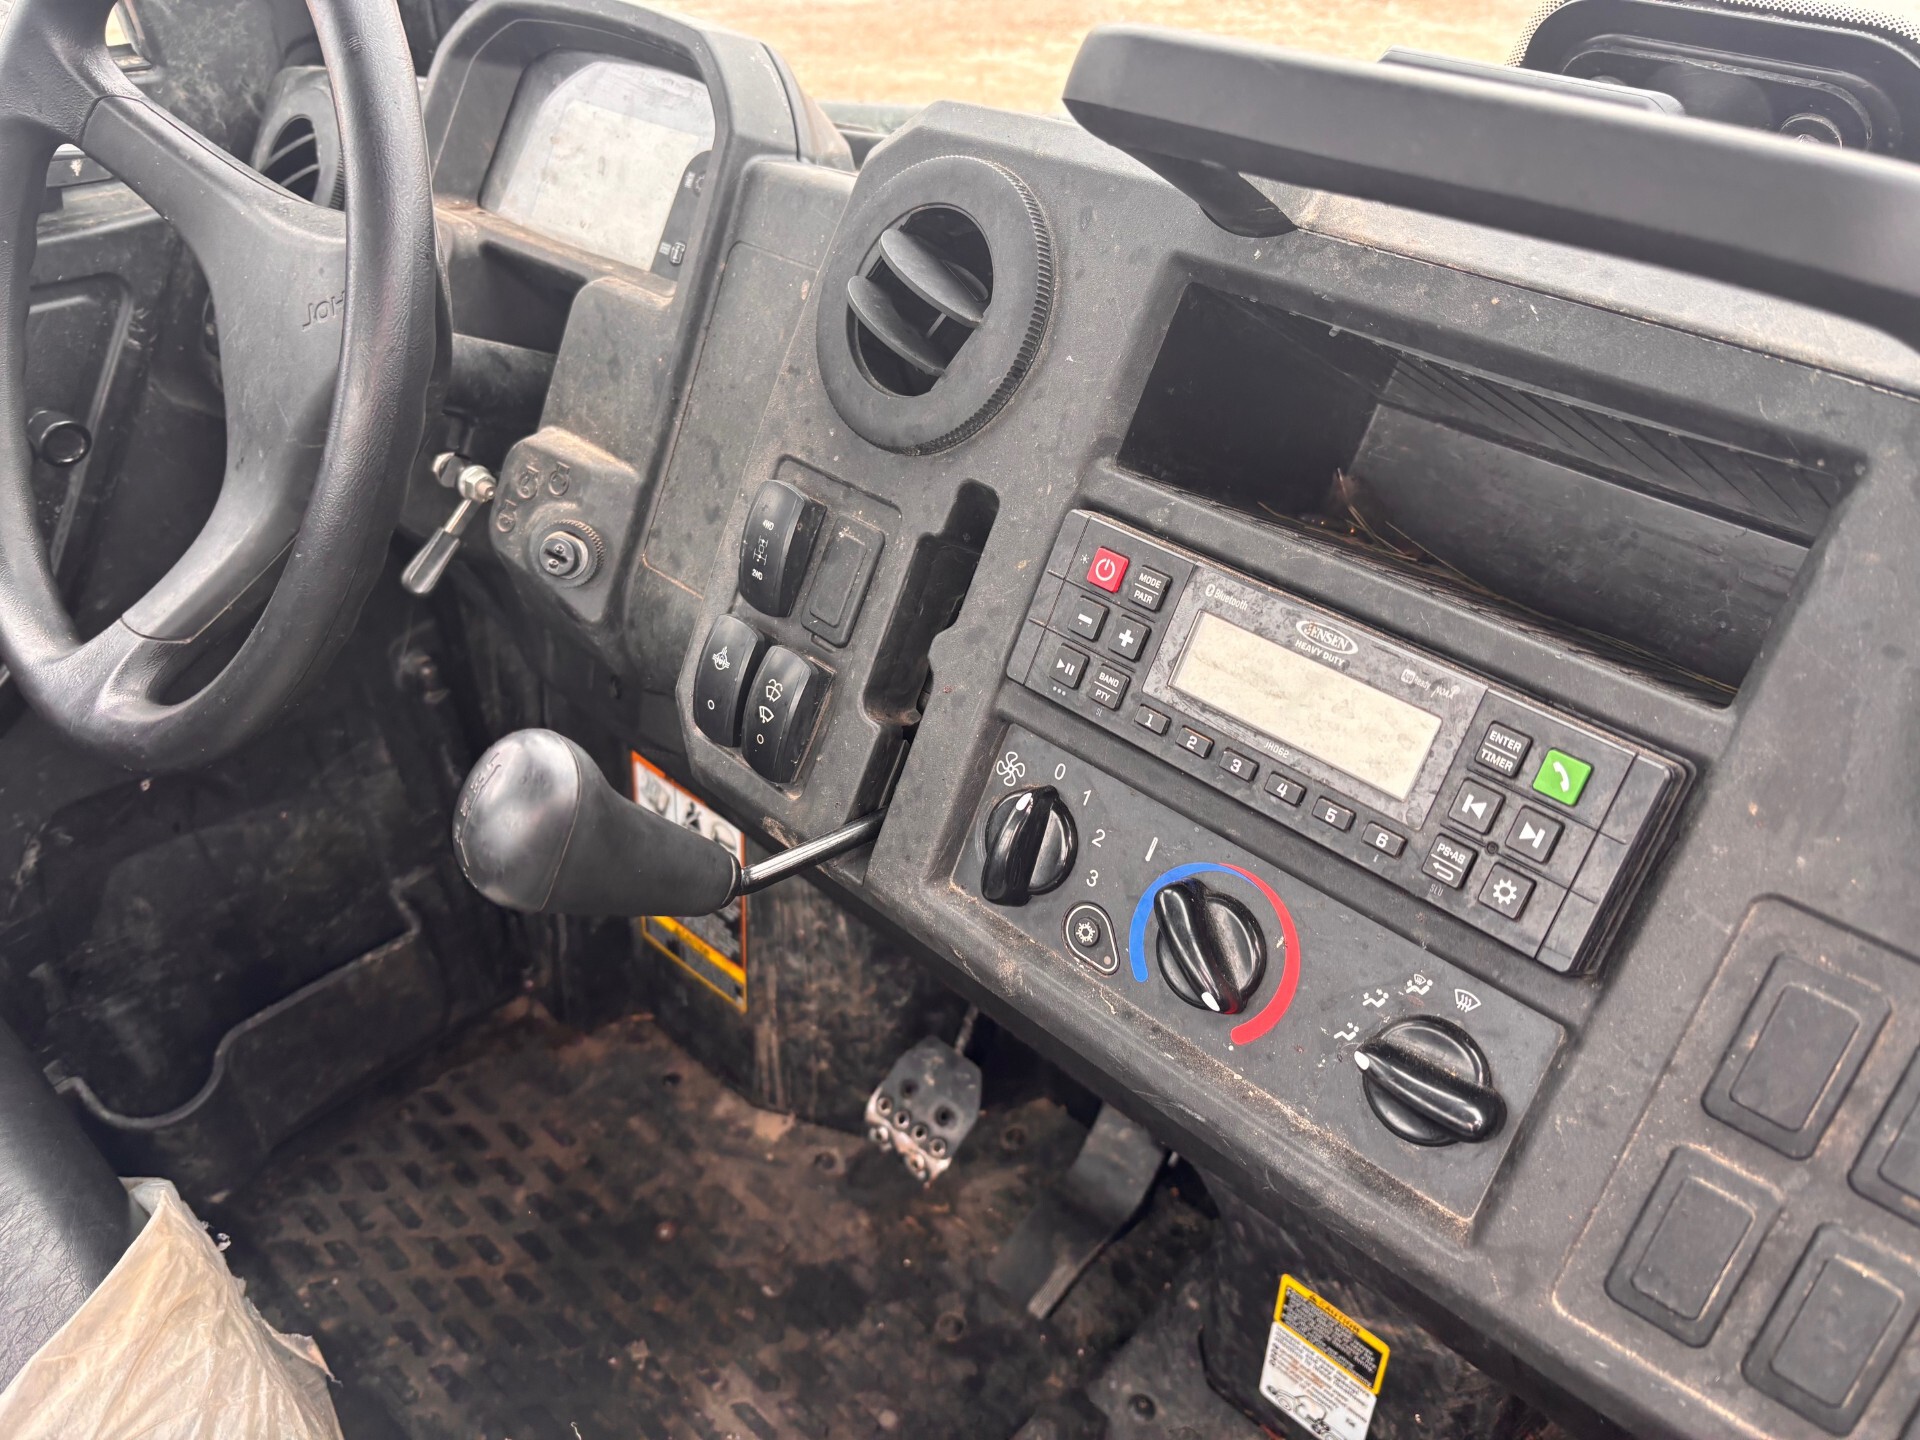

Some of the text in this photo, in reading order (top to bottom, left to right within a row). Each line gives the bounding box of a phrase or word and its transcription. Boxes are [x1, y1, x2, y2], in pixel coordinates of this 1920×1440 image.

[751, 568, 763, 581] 2WD
[1138, 572, 1162, 589] MODE
[1133, 589, 1153, 605] PAIR
[1214, 588, 1249, 611] Bluetooth
[1303, 622, 1350, 651] JENSEN
[1294, 638, 1346, 667] HEAVY DUTY
[1098, 671, 1120, 688] BAND
[1095, 688, 1111, 702] PTY
[1144, 713, 1153, 727] 1
[1186, 736, 1198, 750] 2
[1263, 741, 1290, 759] JHD62
[1489, 730, 1522, 753] ENTER
[1230, 759, 1242, 773] 3
[1481, 748, 1514, 772] TIMER
[1054, 763, 1066, 780] 0
[1083, 790, 1092, 806] 1
[1276, 782, 1288, 798] 4
[1325, 808, 1336, 823] 5
[1092, 829, 1106, 848] 2
[1375, 832, 1389, 848] 6
[1086, 870, 1099, 887] 3
